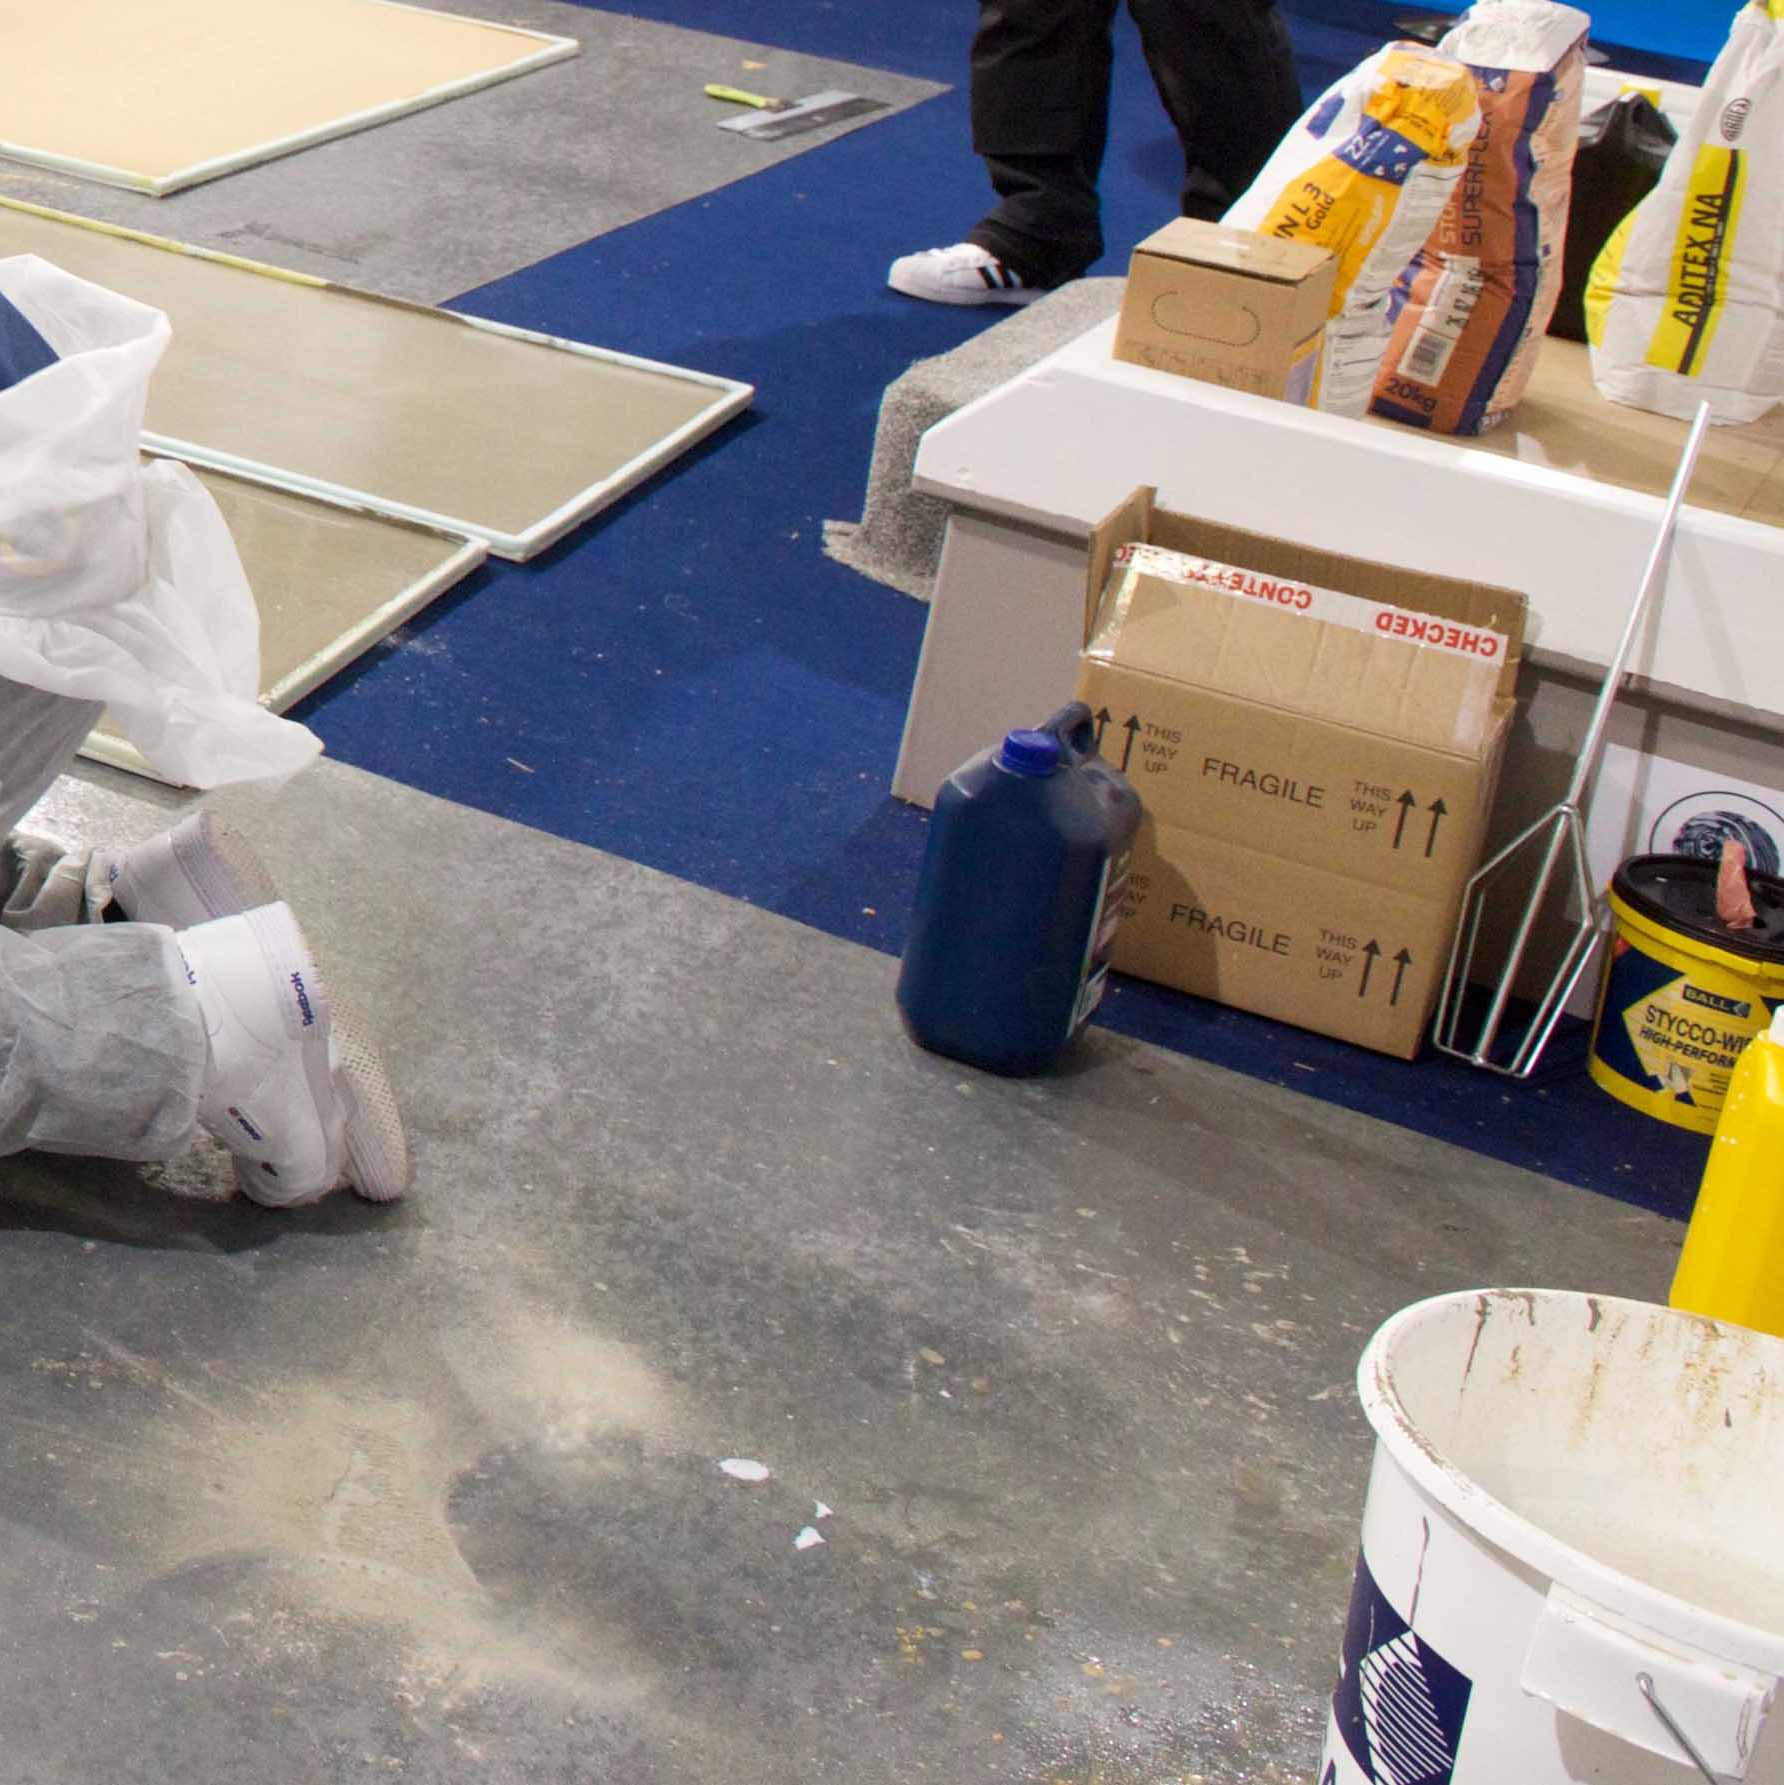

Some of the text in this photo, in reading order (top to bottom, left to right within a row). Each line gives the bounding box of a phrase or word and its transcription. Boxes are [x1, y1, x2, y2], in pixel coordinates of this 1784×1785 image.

[1292, 195, 1311, 215] L
[1304, 180, 1324, 198] 3
[1305, 193, 1337, 233] Gold
[1671, 238, 1713, 328] ADITEX
[1698, 191, 1725, 233] NA
[1384, 375, 1439, 415] 20kg
[1374, 610, 1499, 659] CHECKED
[1145, 722, 1182, 744] THIS
[1141, 741, 1179, 761] WAY
[1144, 760, 1168, 775] UP
[1202, 757, 1326, 809] FRAGILE
[1354, 781, 1392, 802] THIS
[1349, 798, 1388, 817] WAY
[1352, 818, 1378, 834] UP
[1169, 903, 1292, 957] FRAGILE
[1318, 928, 1358, 951] THIS
[1315, 946, 1355, 965] WAY
[1318, 966, 1343, 981] UP
[1685, 989, 1731, 1011] BALL
